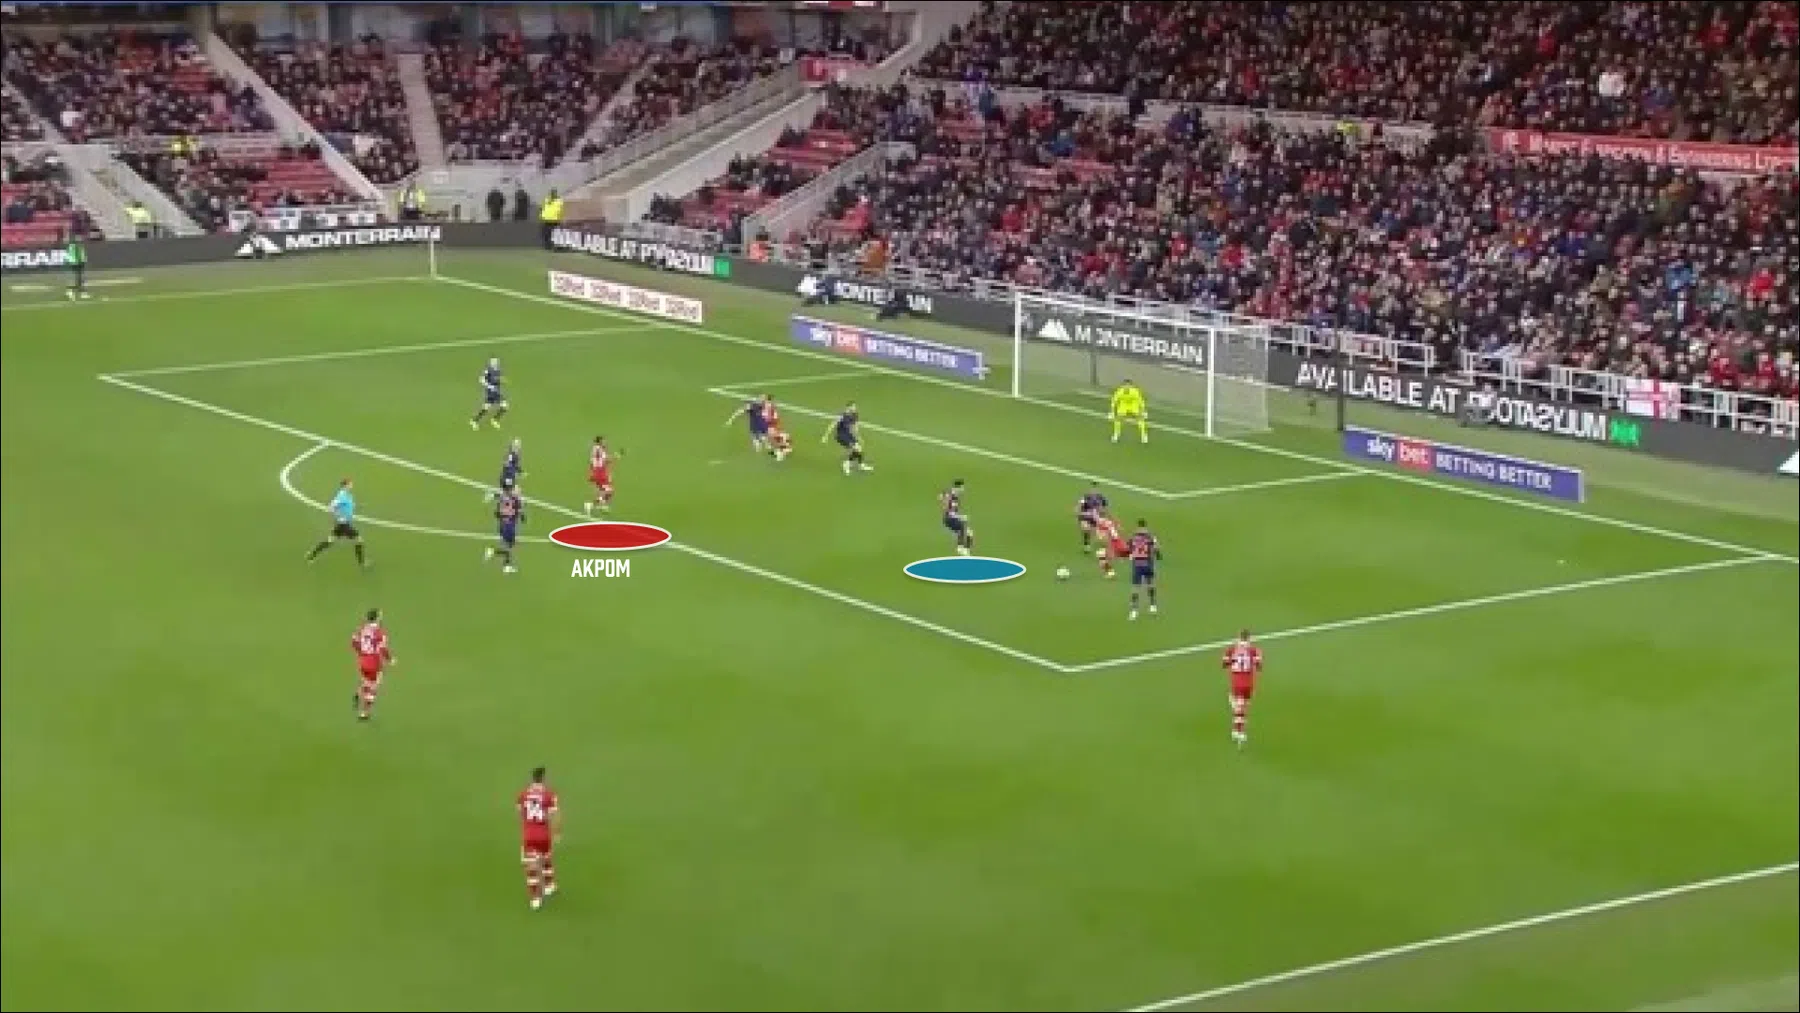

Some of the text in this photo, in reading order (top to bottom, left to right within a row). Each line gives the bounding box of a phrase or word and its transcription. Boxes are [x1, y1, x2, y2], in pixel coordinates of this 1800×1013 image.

[1430, 384, 1461, 413] AT
[1367, 436, 1395, 462] sky
[1436, 452, 1495, 480] BETTING
[1500, 464, 1551, 491] BETTER
